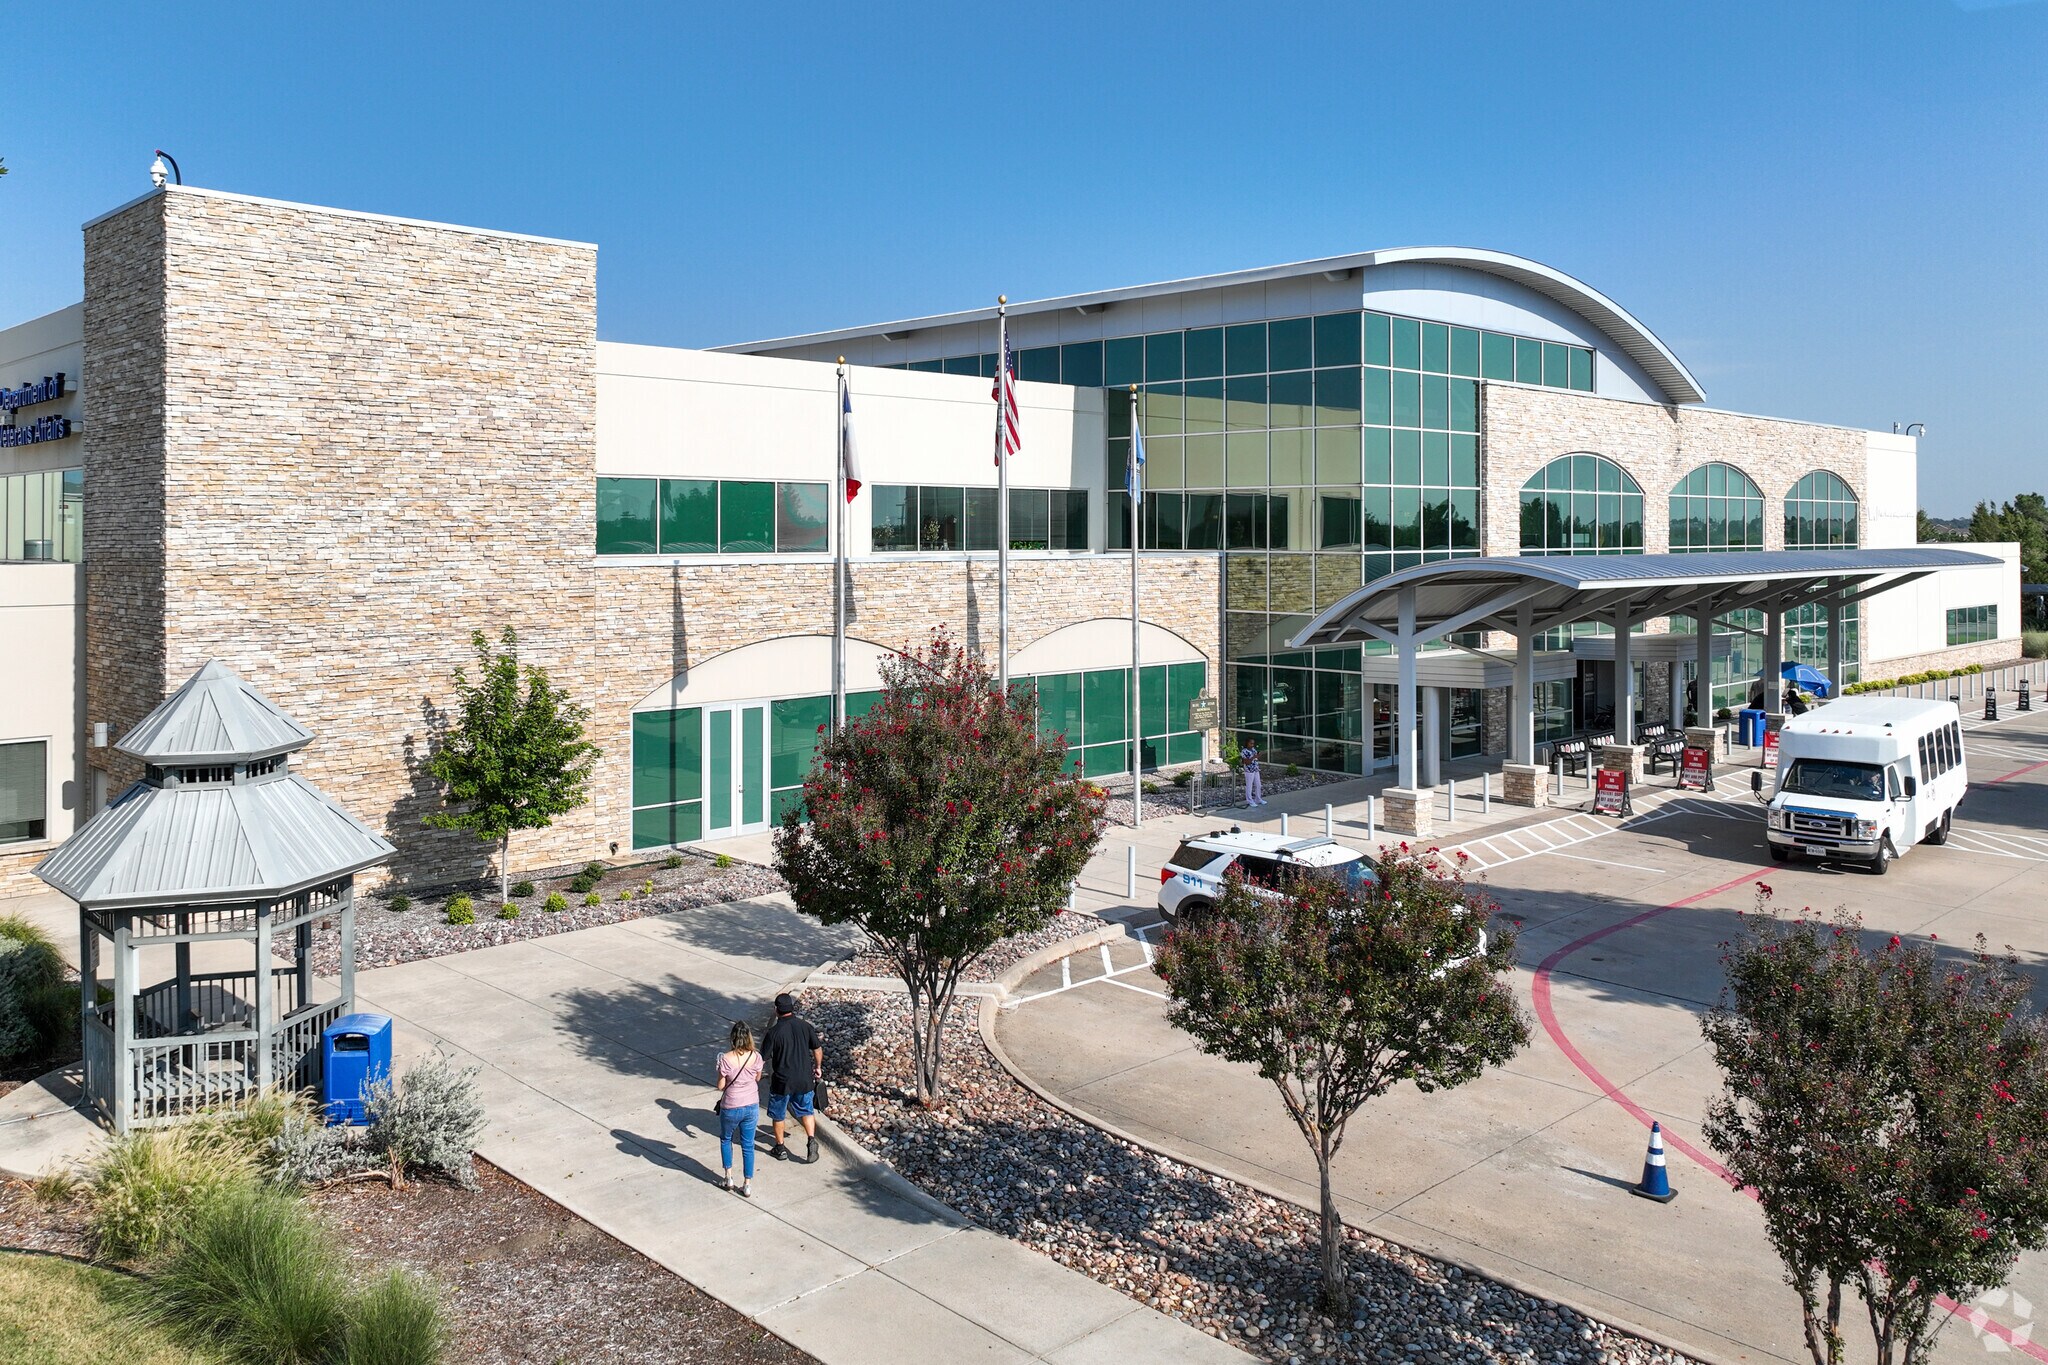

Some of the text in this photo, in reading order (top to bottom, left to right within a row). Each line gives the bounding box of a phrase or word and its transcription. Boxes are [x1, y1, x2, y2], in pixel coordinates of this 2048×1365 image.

[48, 374, 61, 400] of
[34, 416, 64, 443] Affairs
[1183, 874, 1203, 888] 911
